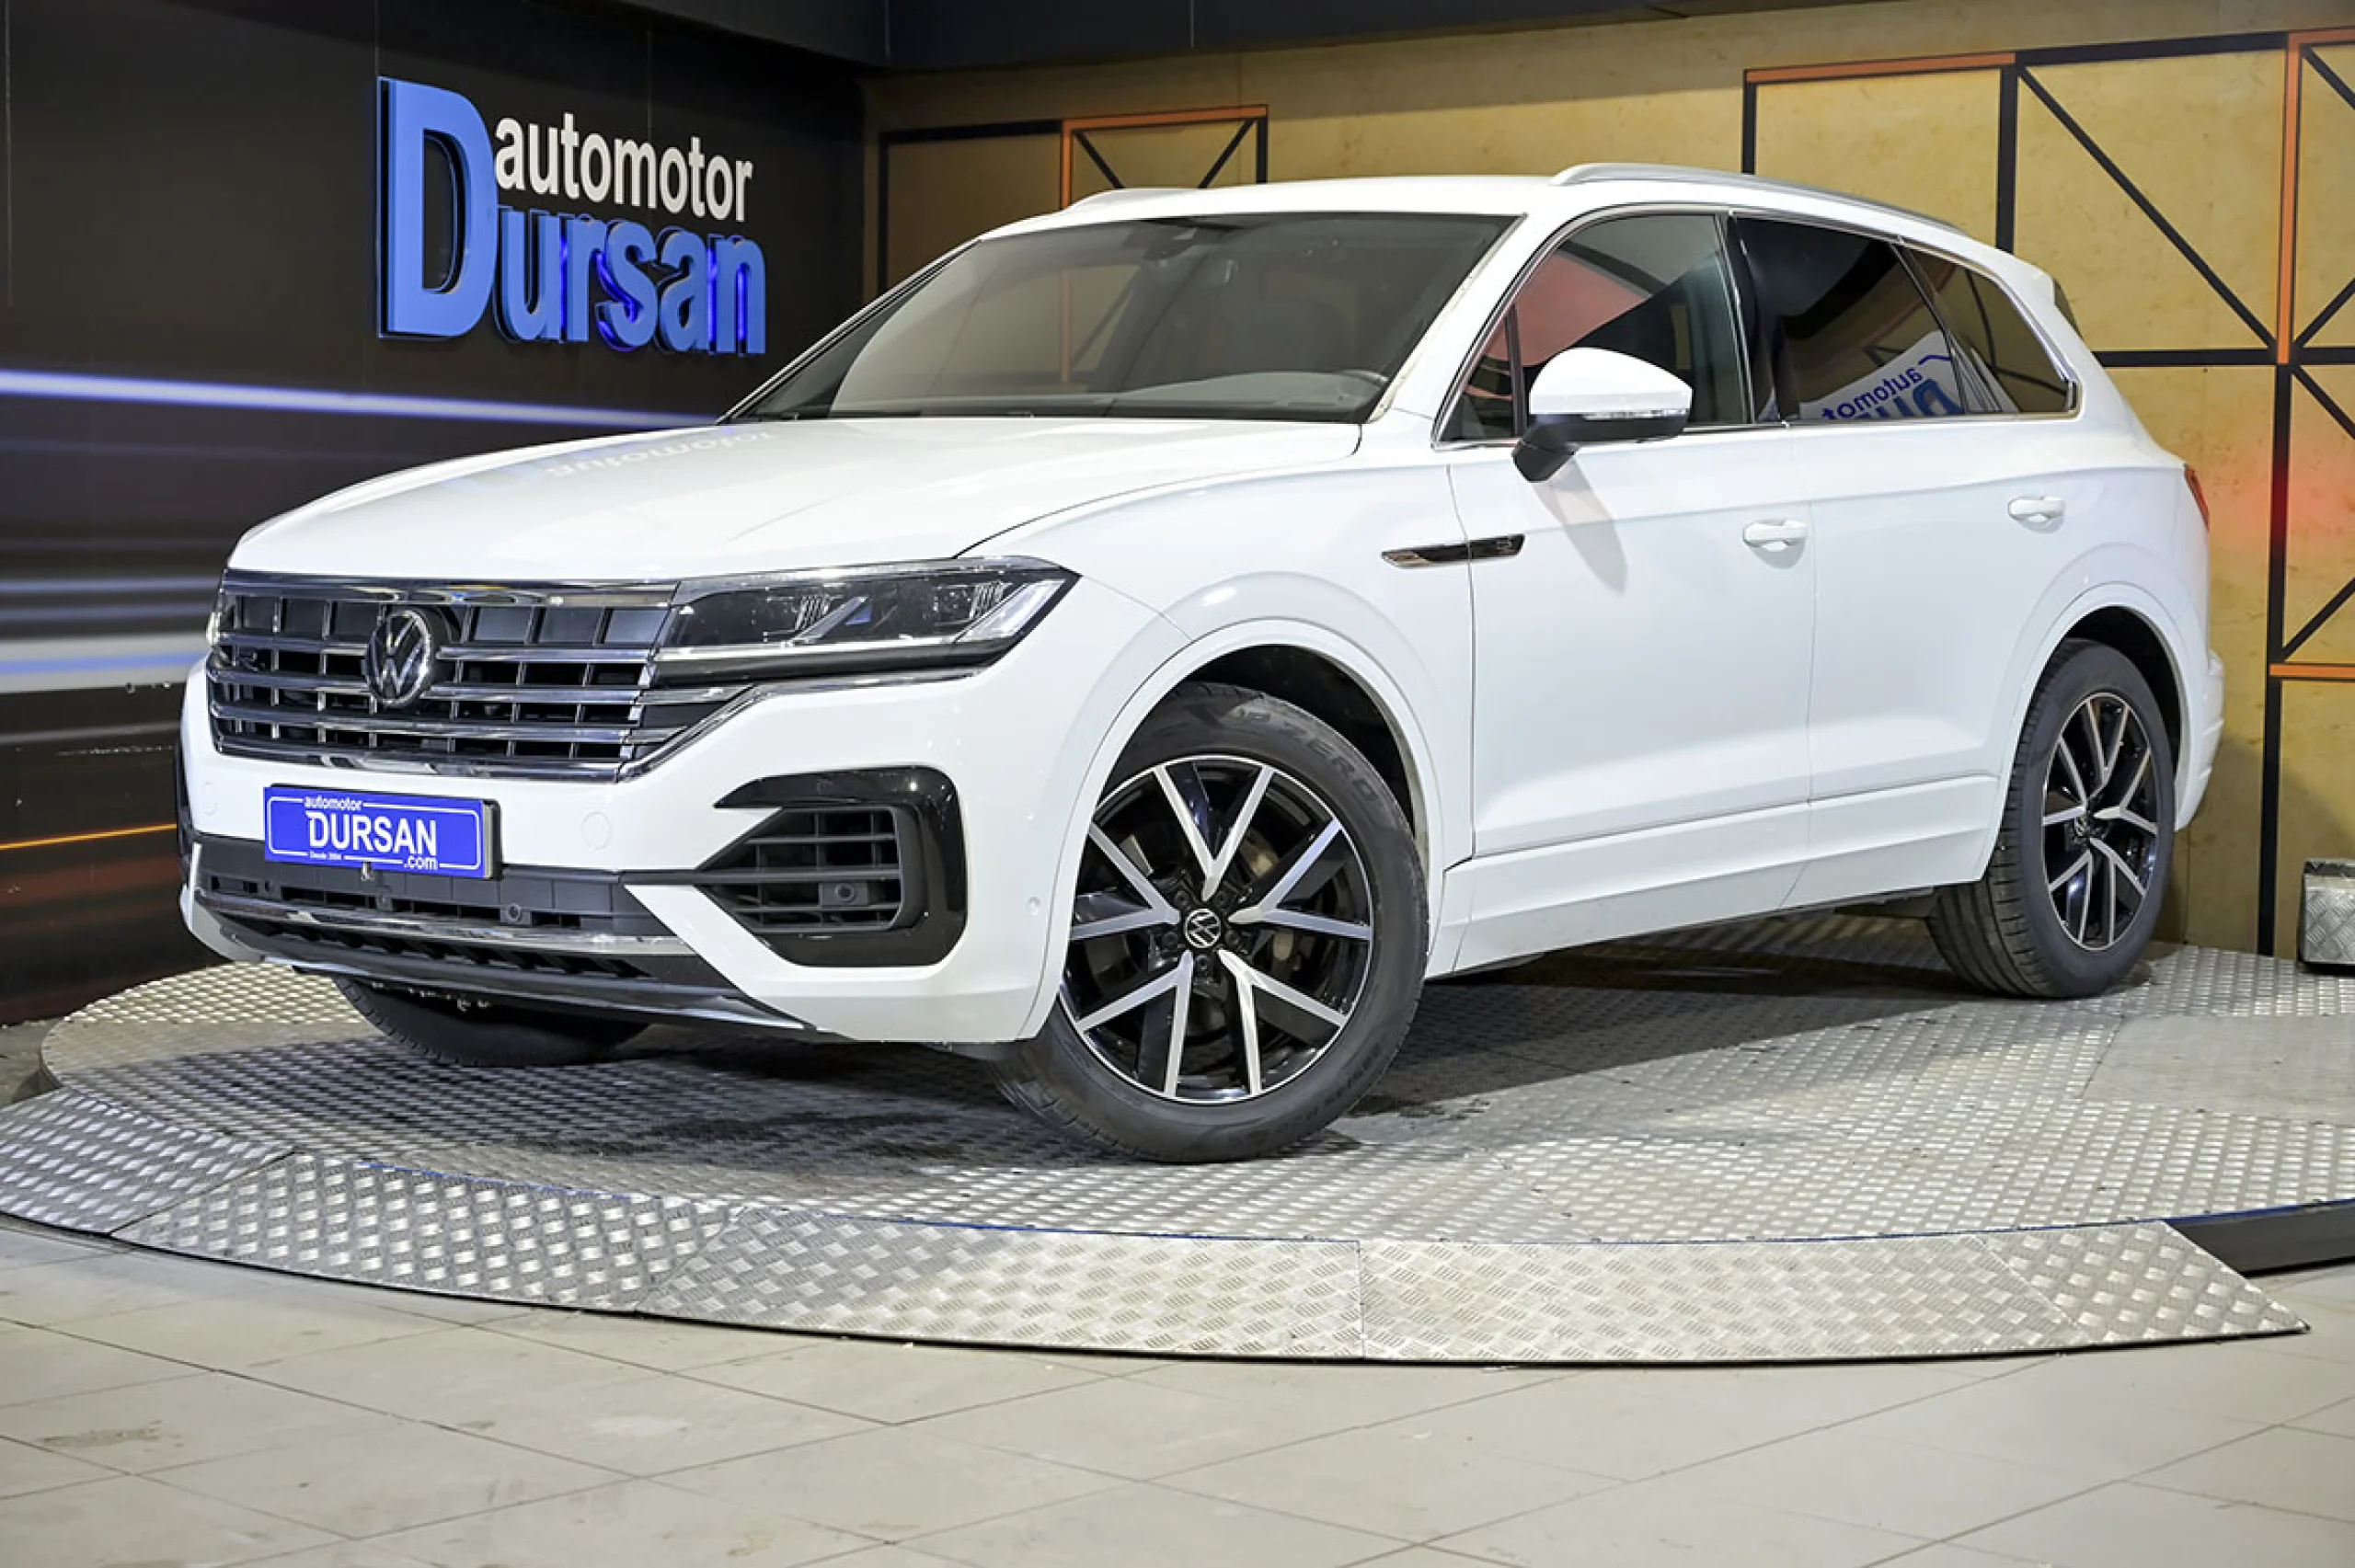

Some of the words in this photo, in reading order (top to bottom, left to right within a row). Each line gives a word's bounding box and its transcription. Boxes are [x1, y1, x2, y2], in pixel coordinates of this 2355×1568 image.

[494, 110, 753, 223] automotor
[377, 75, 766, 356] Dursan
[304, 794, 362, 811] automotor
[305, 810, 437, 857] DURSAN
[403, 855, 439, 871] .com
